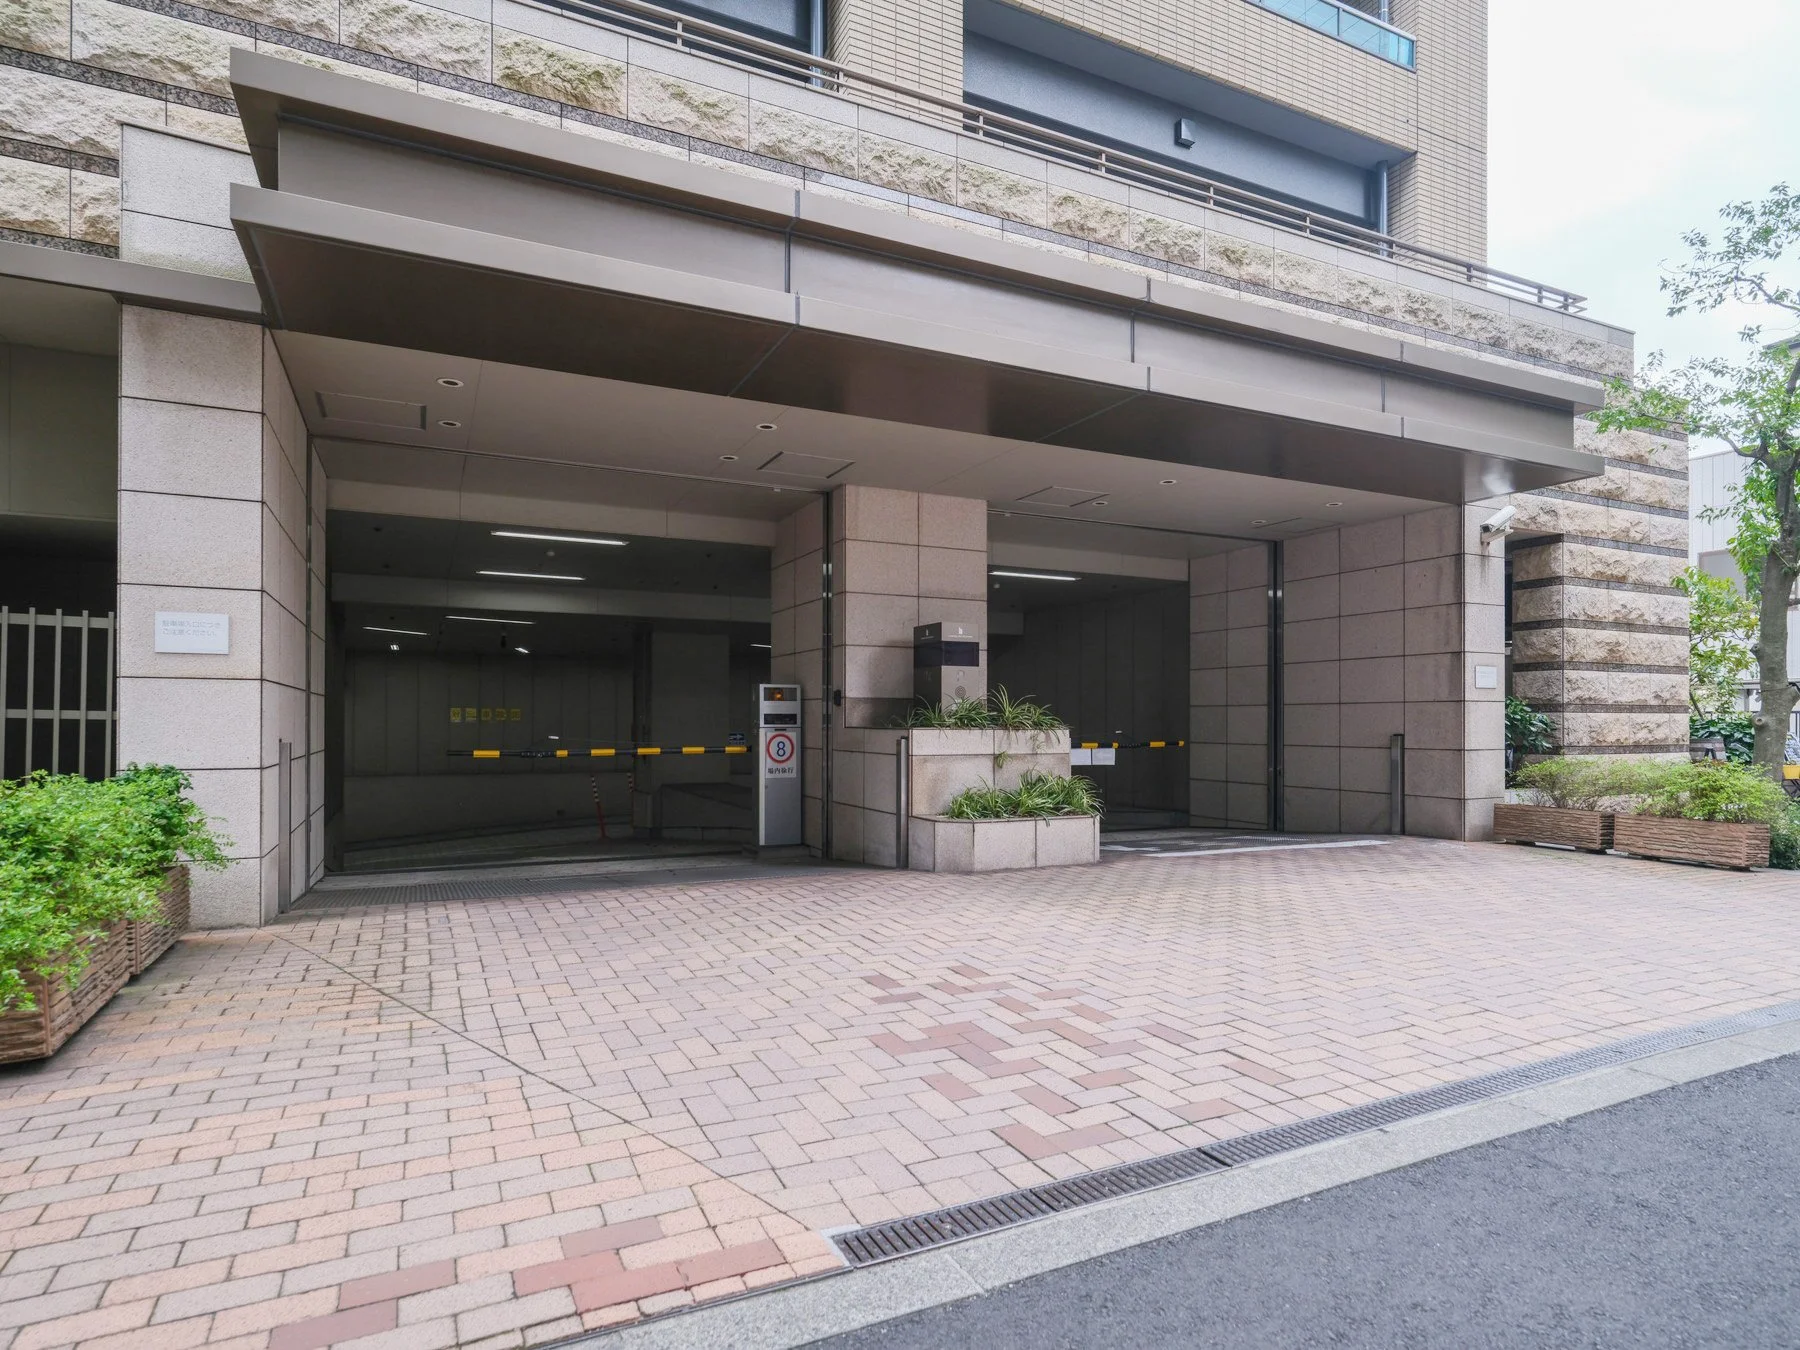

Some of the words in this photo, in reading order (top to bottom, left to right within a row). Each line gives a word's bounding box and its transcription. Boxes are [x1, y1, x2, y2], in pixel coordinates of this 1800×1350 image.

[776, 741, 786, 757] 8
[767, 767, 794, 775] 場内徐行
